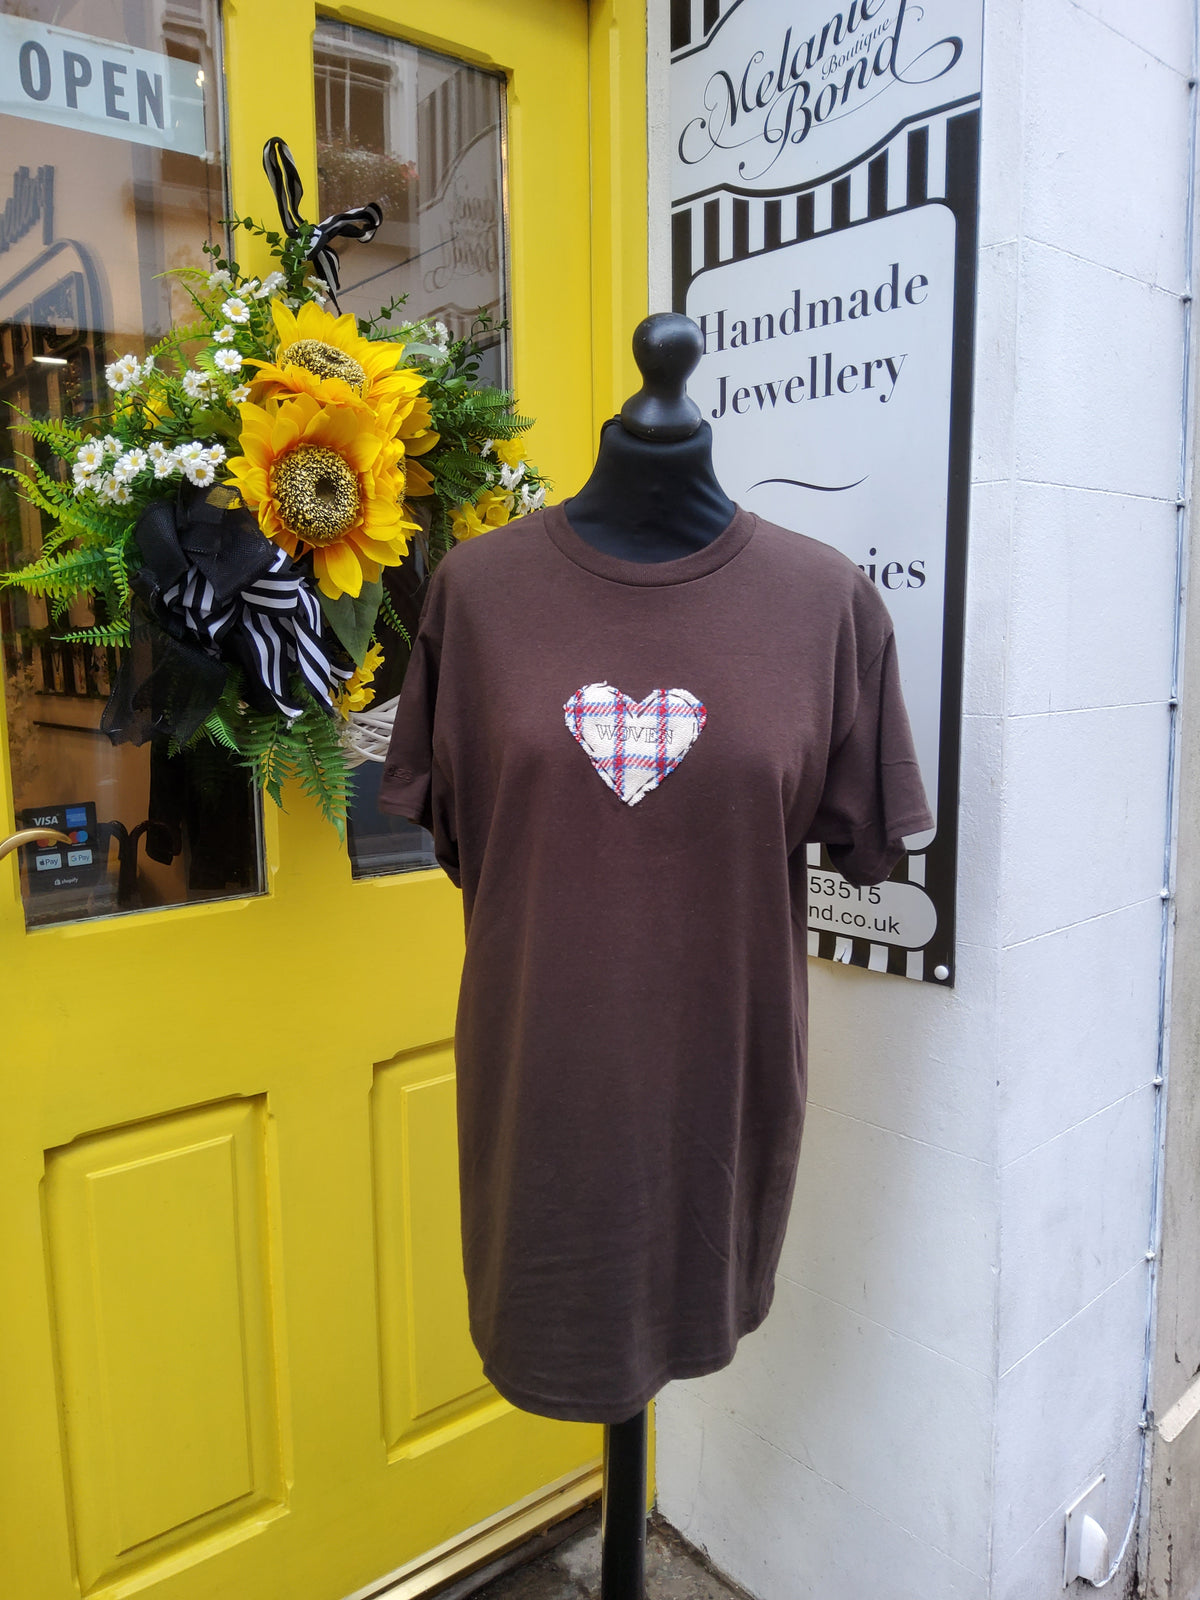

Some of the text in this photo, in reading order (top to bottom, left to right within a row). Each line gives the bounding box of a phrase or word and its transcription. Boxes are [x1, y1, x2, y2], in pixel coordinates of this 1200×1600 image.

[821, 17, 898, 80] Boutique
[19, 40, 165, 130] OPEN
[679, 0, 889, 165] Melanie
[697, 263, 929, 355] Handmade
[711, 352, 909, 419] Jewellery
[595, 724, 674, 744] WOVEN
[33, 815, 59, 826] VISA
[46, 858, 59, 866] Pay
[809, 876, 881, 905] 53515
